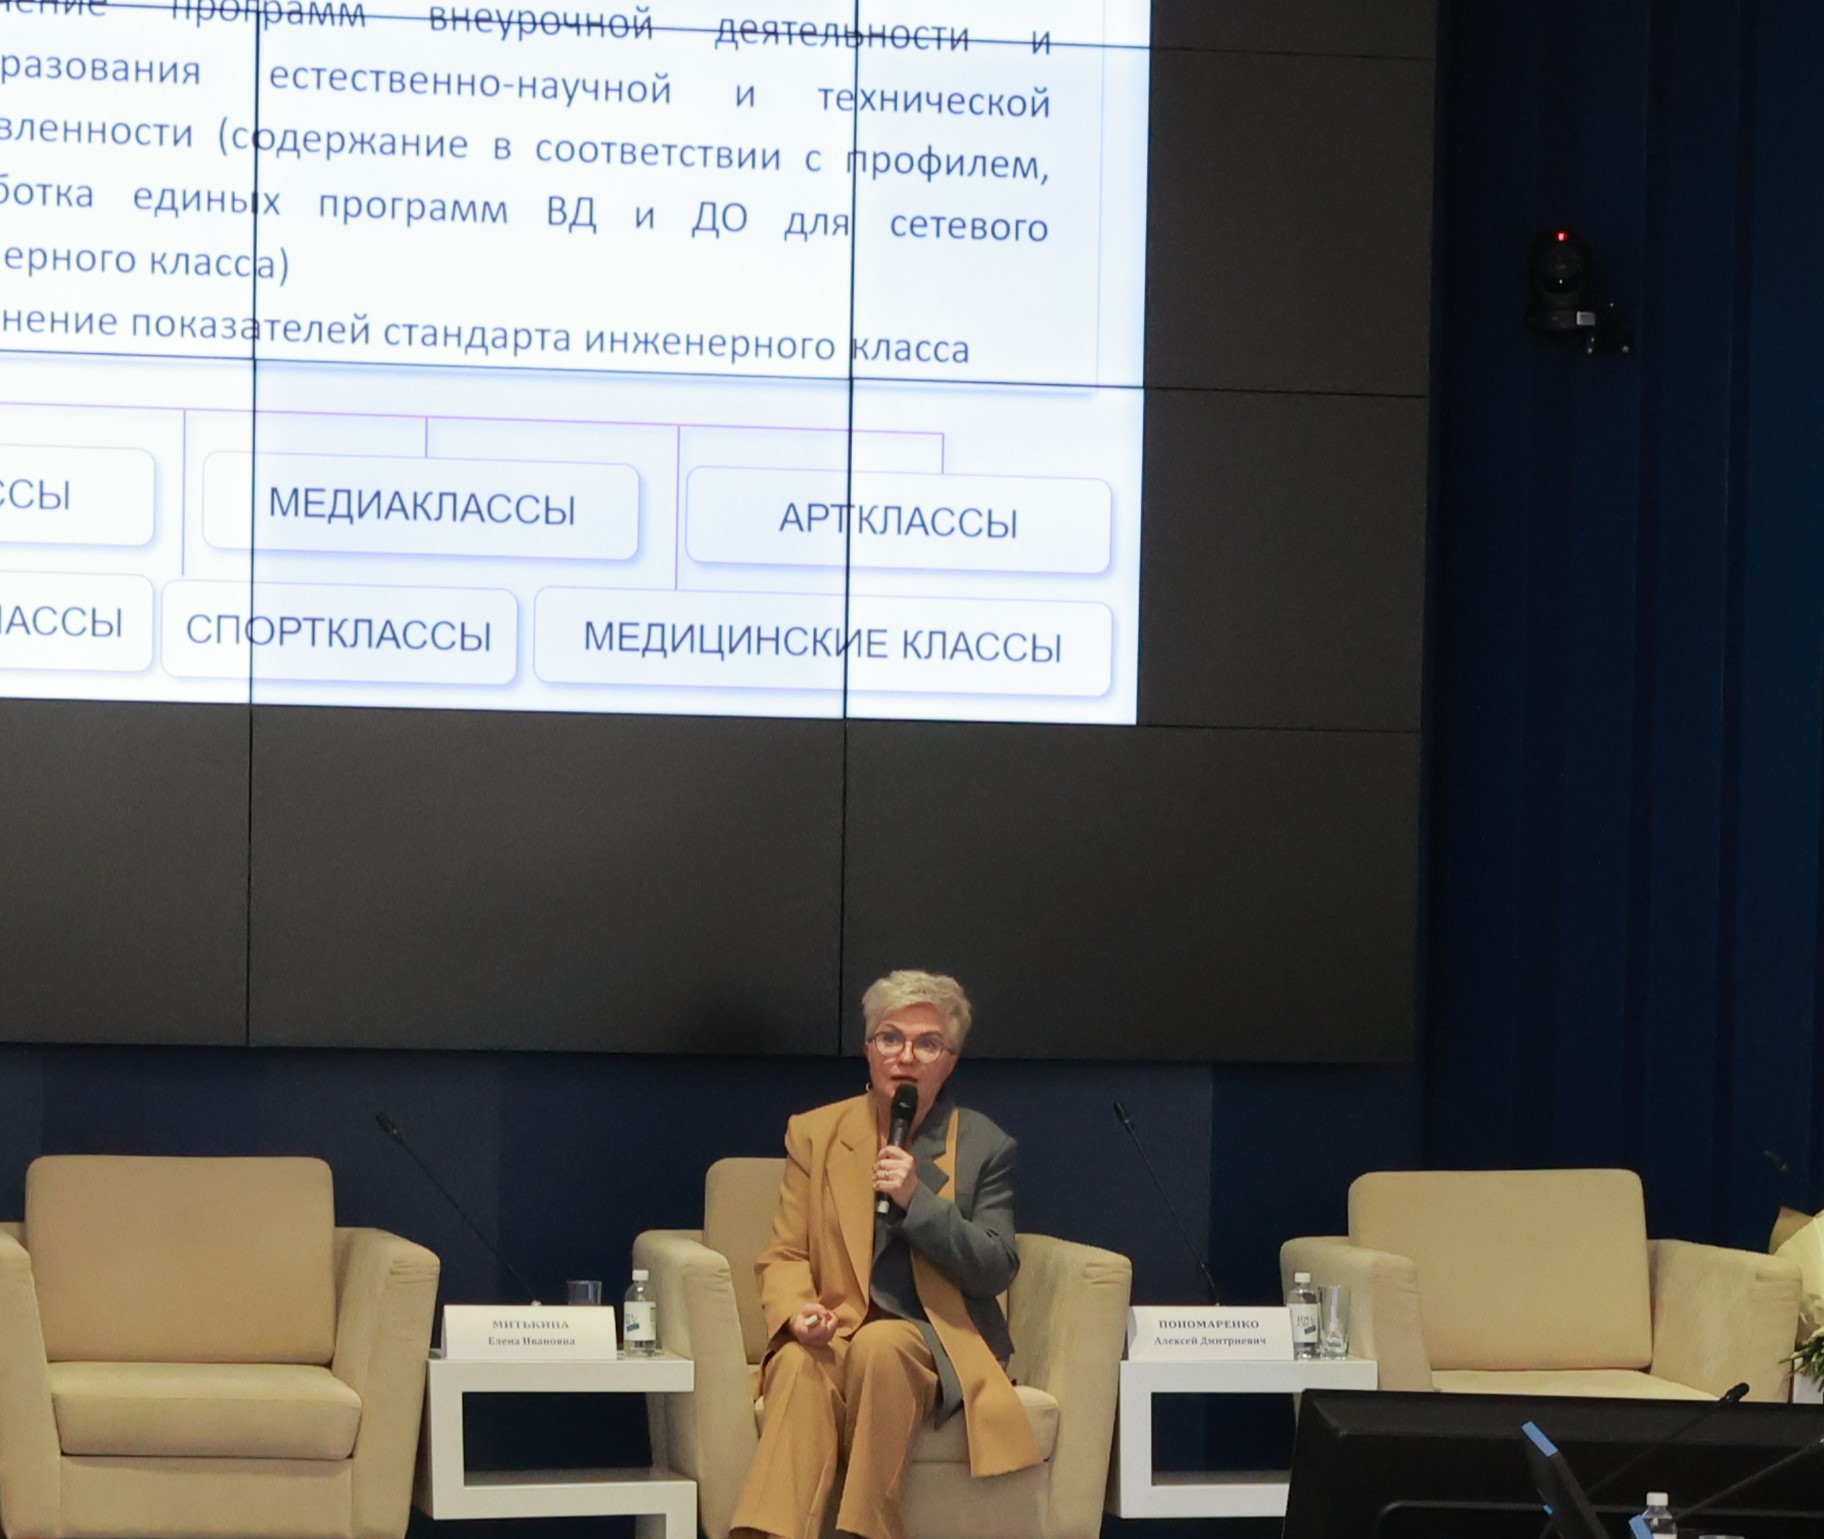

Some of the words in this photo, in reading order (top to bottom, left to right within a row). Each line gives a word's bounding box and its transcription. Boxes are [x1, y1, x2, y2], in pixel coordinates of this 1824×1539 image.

[429, 5, 654, 42] внеурочной
[715, 17, 970, 53] деятельности
[1031, 30, 1052, 56] и
[269, 64, 672, 107] естественно-научной
[735, 83, 756, 108] и
[817, 83, 1051, 119] технической
[218, 116, 469, 161] (содержание
[493, 136, 512, 160] в
[535, 138, 783, 172] соответствии
[804, 153, 823, 173] с
[846, 145, 1051, 185] профилем,
[132, 184, 282, 218] единых
[318, 191, 509, 228] программ
[547, 195, 598, 234] ВД
[635, 204, 656, 230] и
[691, 200, 749, 239] ДО
[783, 210, 850, 242] для
[888, 213, 1050, 243] сетевого
[149, 246, 290, 287] класса)
[131, 311, 371, 345] показателей
[383, 321, 572, 357] стандарта
[584, 328, 837, 365] инженерного
[850, 338, 971, 365] класса
[268, 486, 576, 526] МЕДИАКЛАССЫ
[777, 501, 1019, 540] АРТКЛАССЫ
[185, 612, 492, 653] СПОРТКЛАССЫ
[584, 620, 889, 662] МЕДИЦИНСКИЕ
[901, 628, 1063, 665] КЛАССЫ
[1153, 1336, 1198, 1346] Алексей
[1199, 1336, 1267, 1348] Дмитриевич
[1158, 1319, 1260, 1330] ПОНОМАРЕНКО
